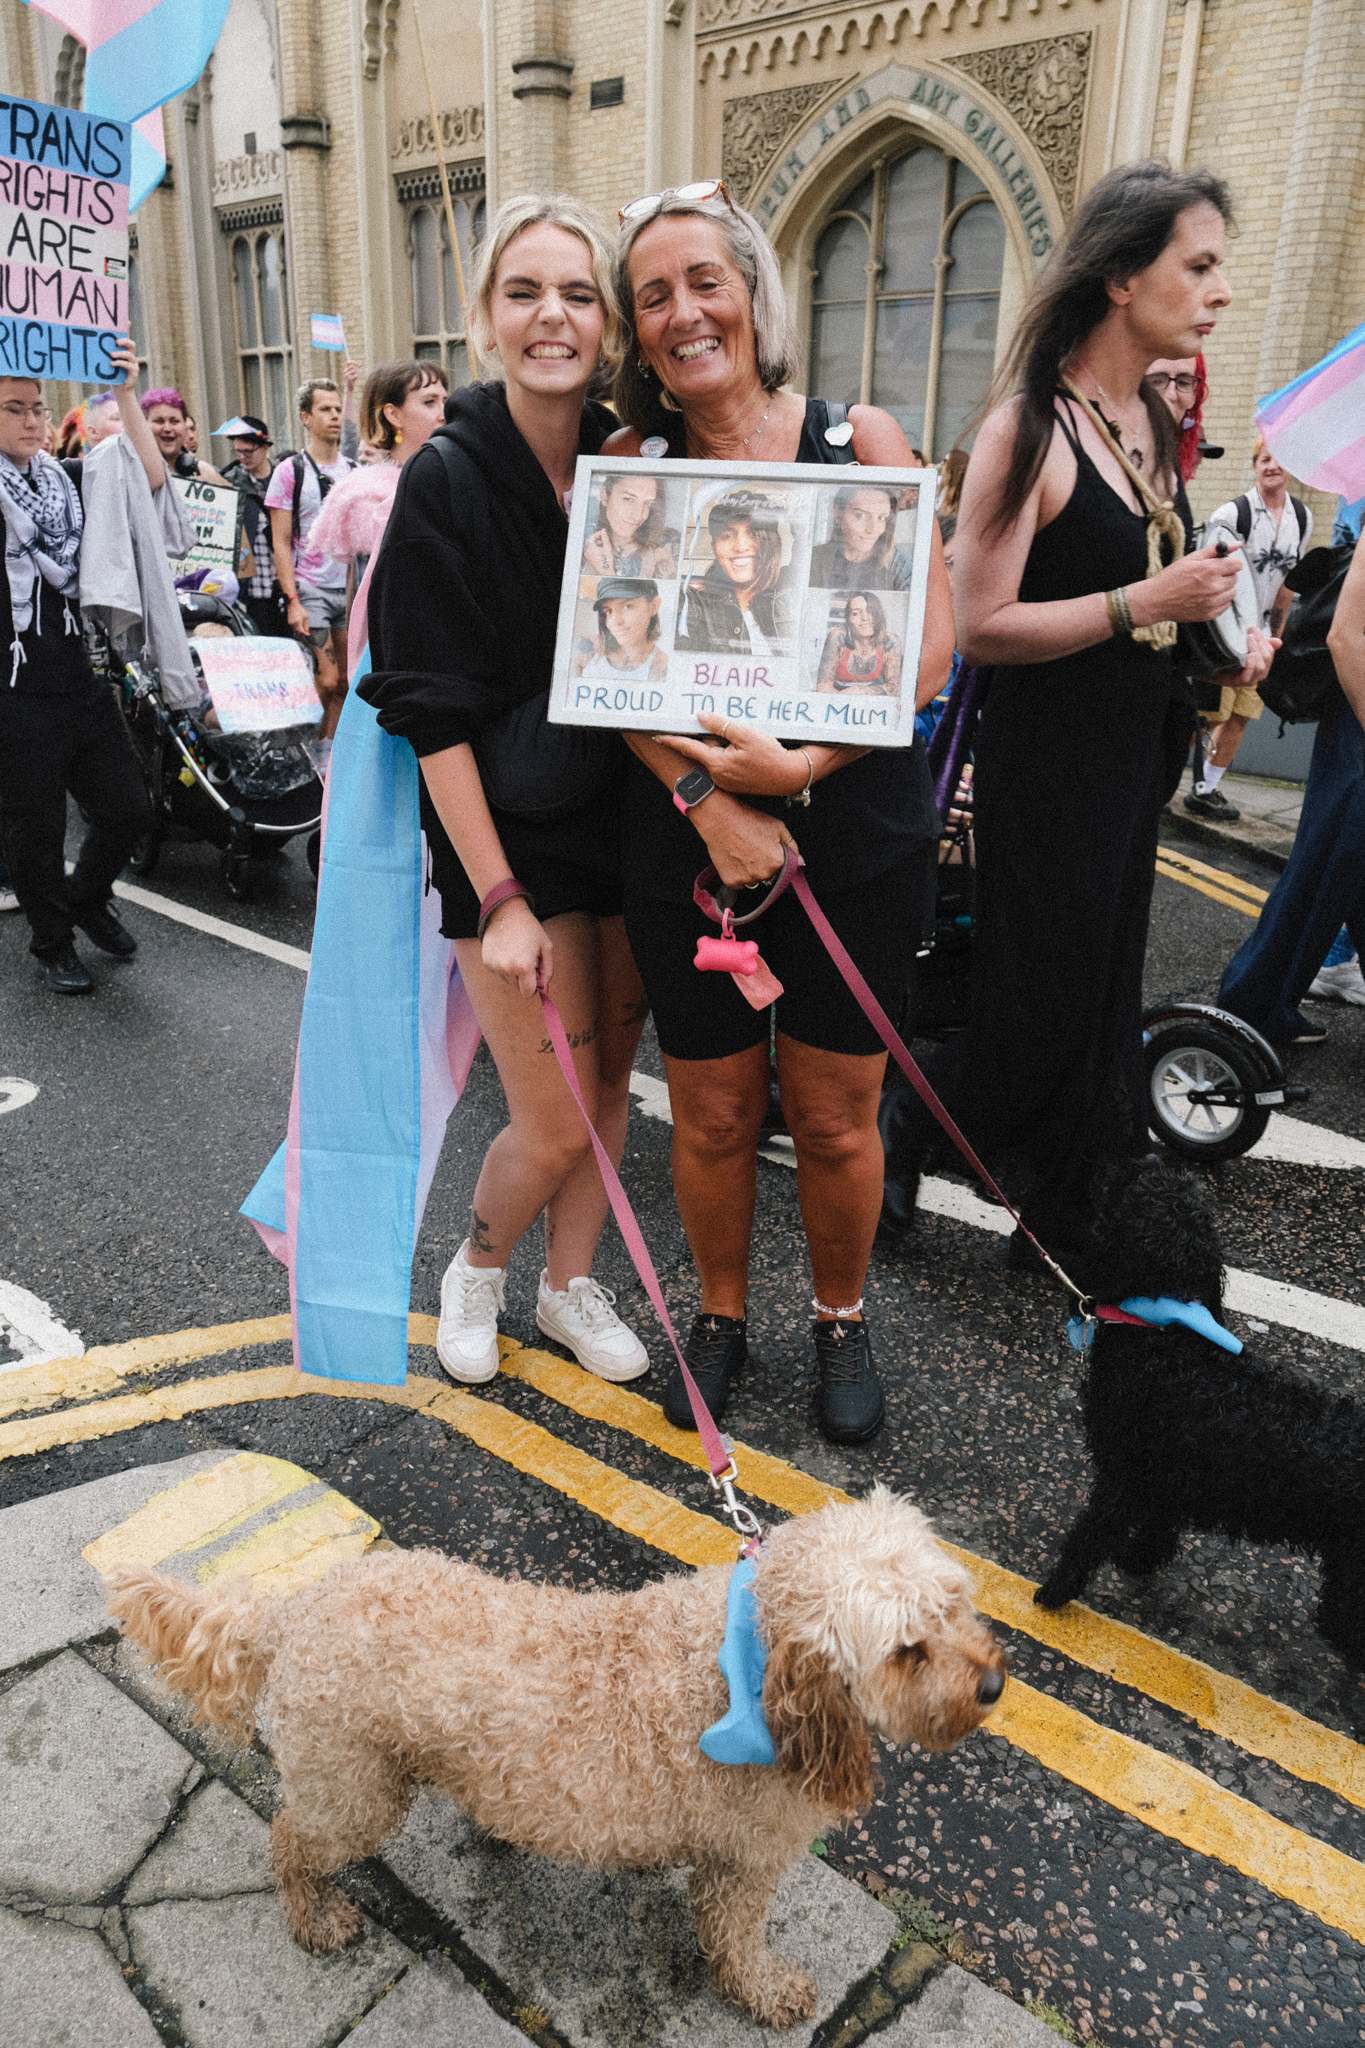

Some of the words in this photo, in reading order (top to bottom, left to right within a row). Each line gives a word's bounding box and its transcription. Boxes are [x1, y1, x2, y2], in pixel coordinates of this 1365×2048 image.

[818, 87, 871, 147] AND
[908, 76, 960, 116] ART
[964, 108, 1053, 257] GALLERIES
[7, 212, 96, 273] ARE
[0, 263, 118, 327] UMAN
[184, 482, 216, 503] NO
[196, 525, 214, 538] IN
[233, 680, 290, 700] TRANS
[693, 662, 775, 688] BLAIR
[574, 684, 663, 712] PROUD
[682, 692, 715, 715] TO
[726, 695, 757, 719] BE
[767, 700, 815, 724] HER
